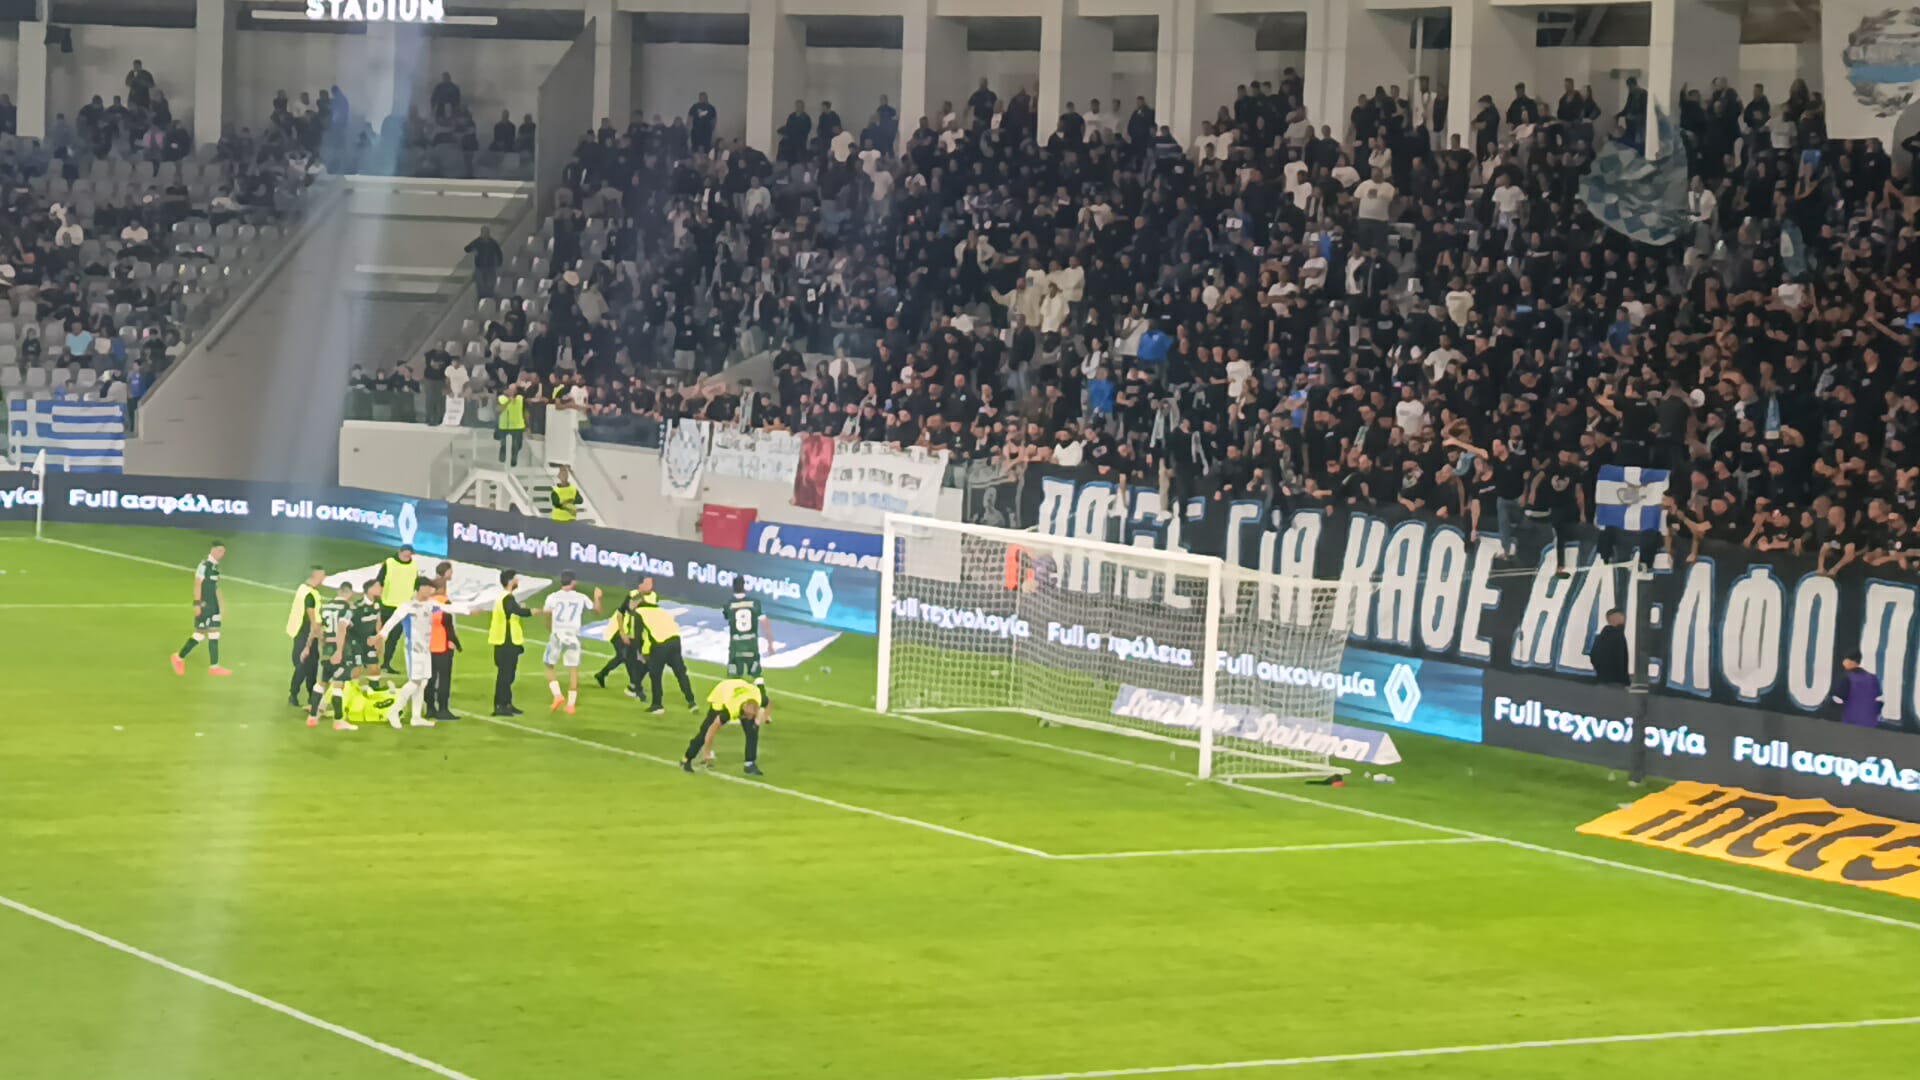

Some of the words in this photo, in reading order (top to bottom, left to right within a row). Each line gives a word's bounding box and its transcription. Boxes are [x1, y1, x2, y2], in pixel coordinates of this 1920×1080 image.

[306, 0, 444, 22] STADIUM
[69, 489, 118, 508] Full
[120, 493, 249, 515] ασφάλεια
[271, 500, 313, 519] Full
[570, 542, 597, 563] Full
[687, 561, 717, 584] Full
[717, 570, 801, 600] οιονομία
[1330, 513, 1502, 661] ΚΑΘΕ
[556, 602, 579, 623] 27
[735, 610, 753, 632] 8
[892, 596, 918, 618] ull
[1048, 622, 1084, 648] Full
[1256, 662, 1376, 697] οικονομία
[1494, 696, 1542, 727] Full
[1733, 736, 1789, 768] Full
